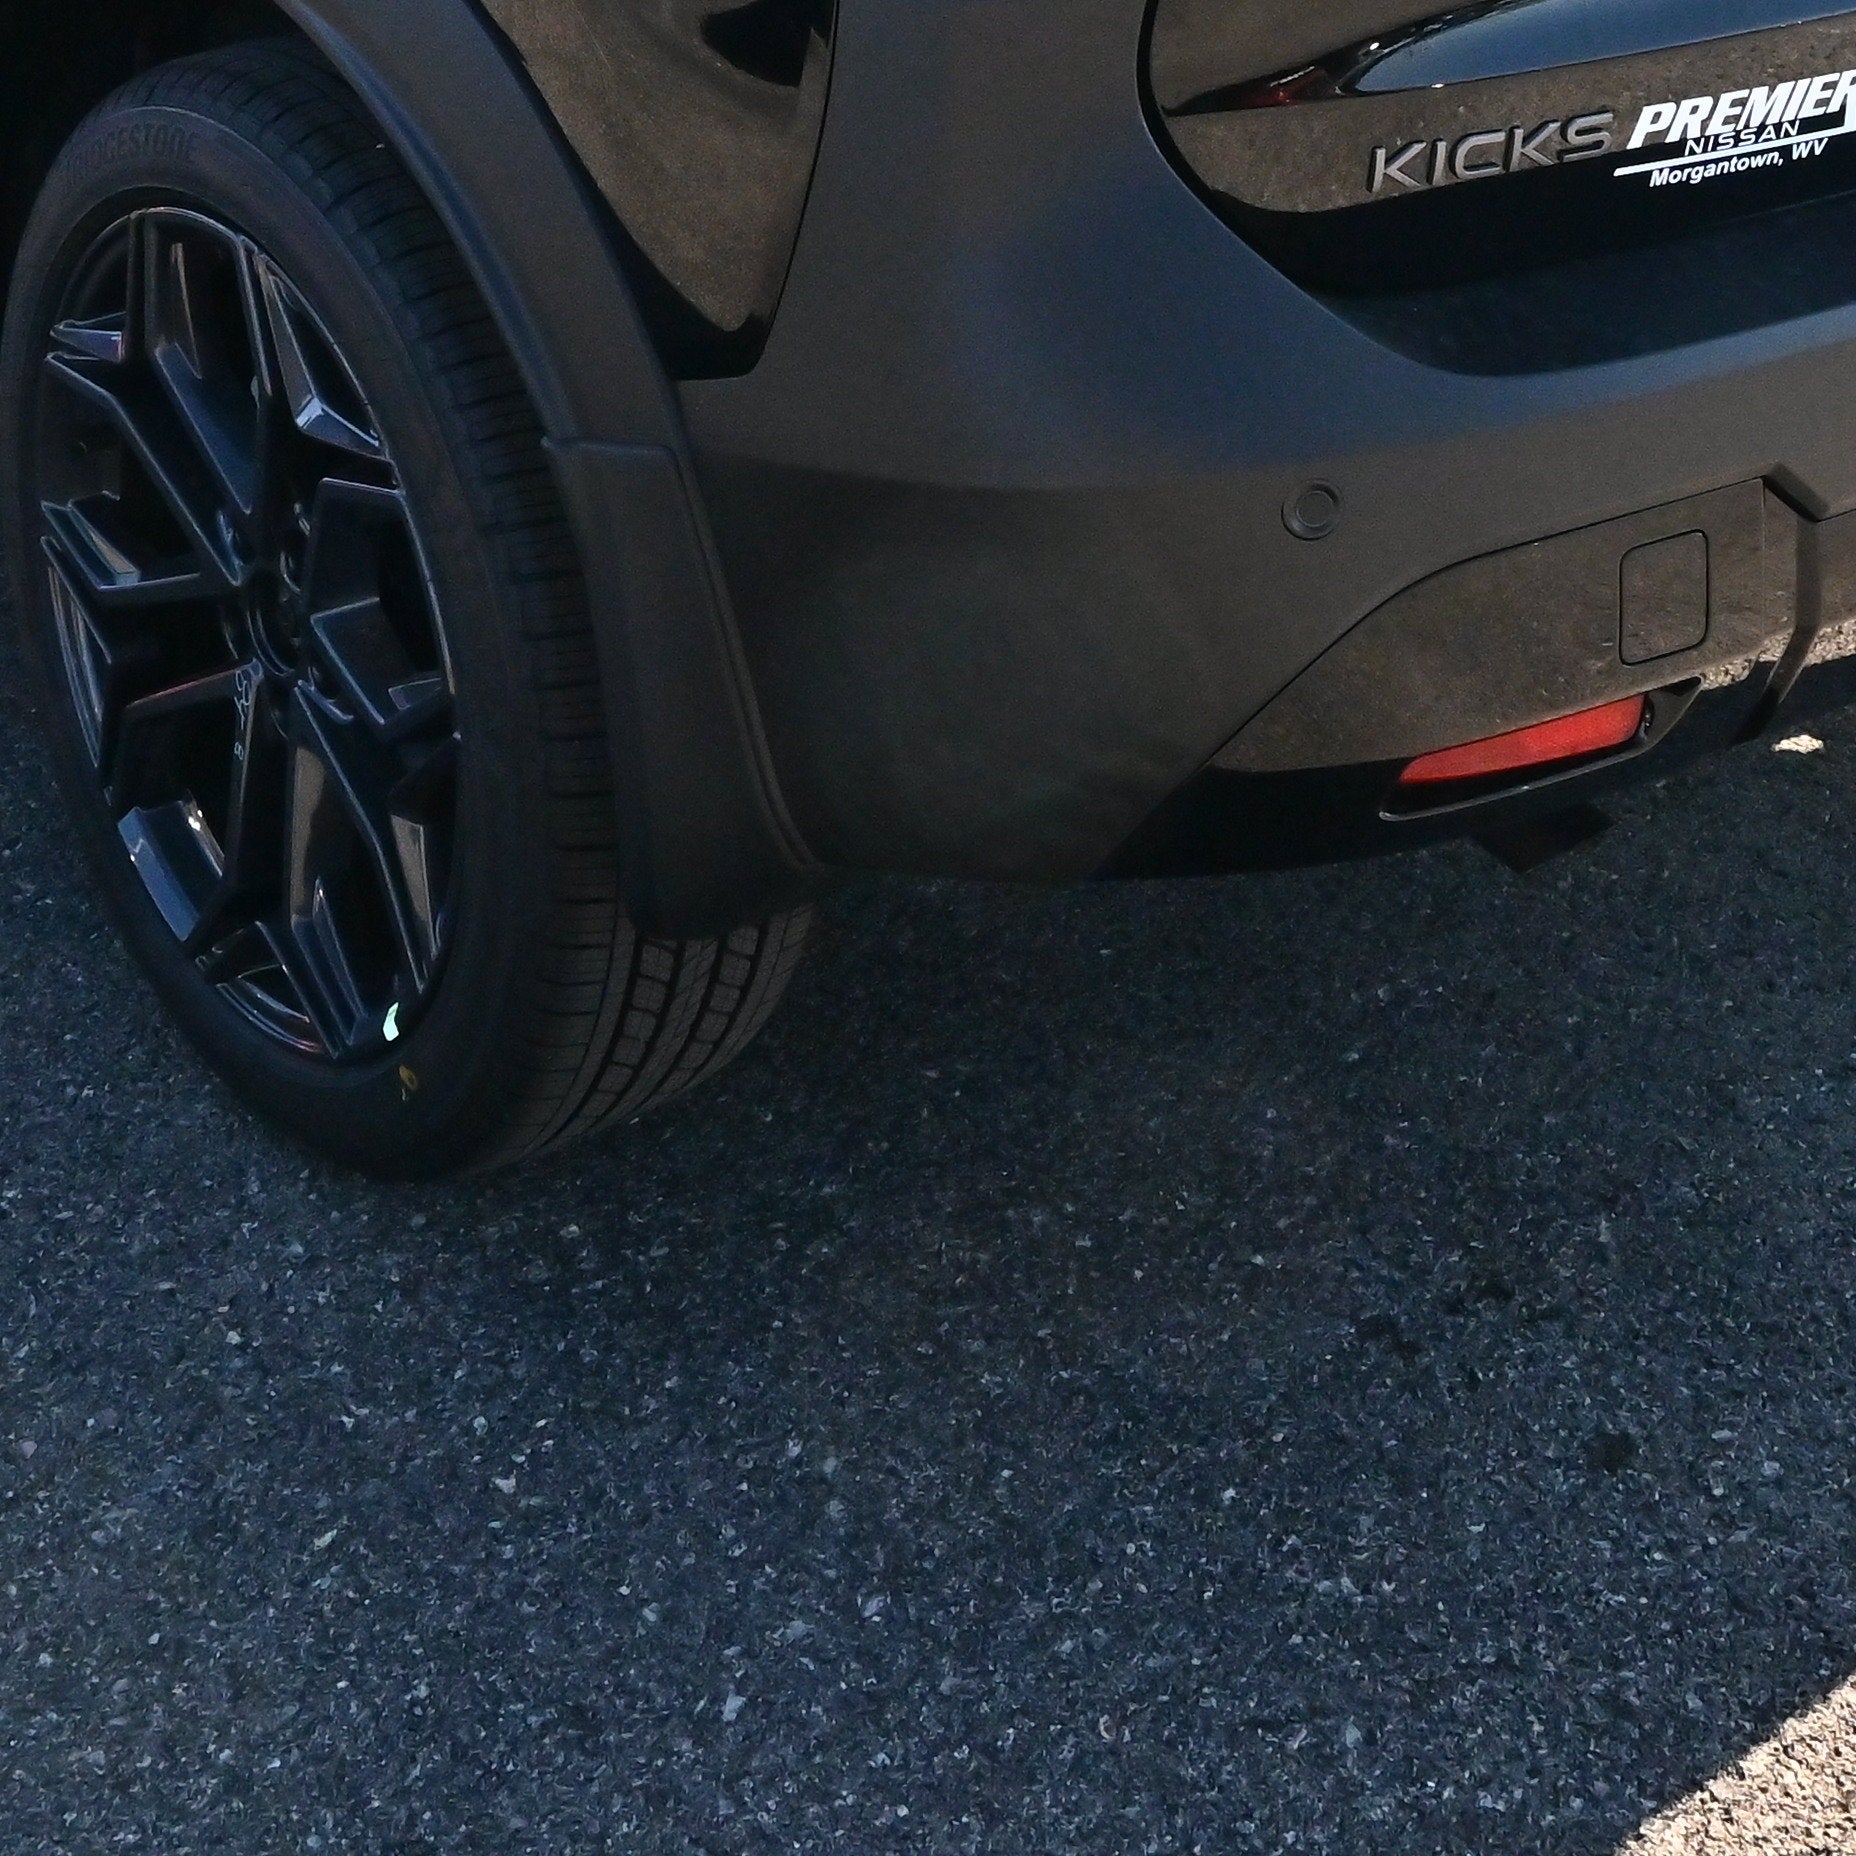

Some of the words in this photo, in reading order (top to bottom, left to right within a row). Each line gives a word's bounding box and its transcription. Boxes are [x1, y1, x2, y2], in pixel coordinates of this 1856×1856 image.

[1368, 113, 1614, 193] KICKS
[1684, 119, 1799, 156] NISSAN
[1649, 150, 1785, 188] Morgantown,
[1790, 138, 1829, 161] WV
